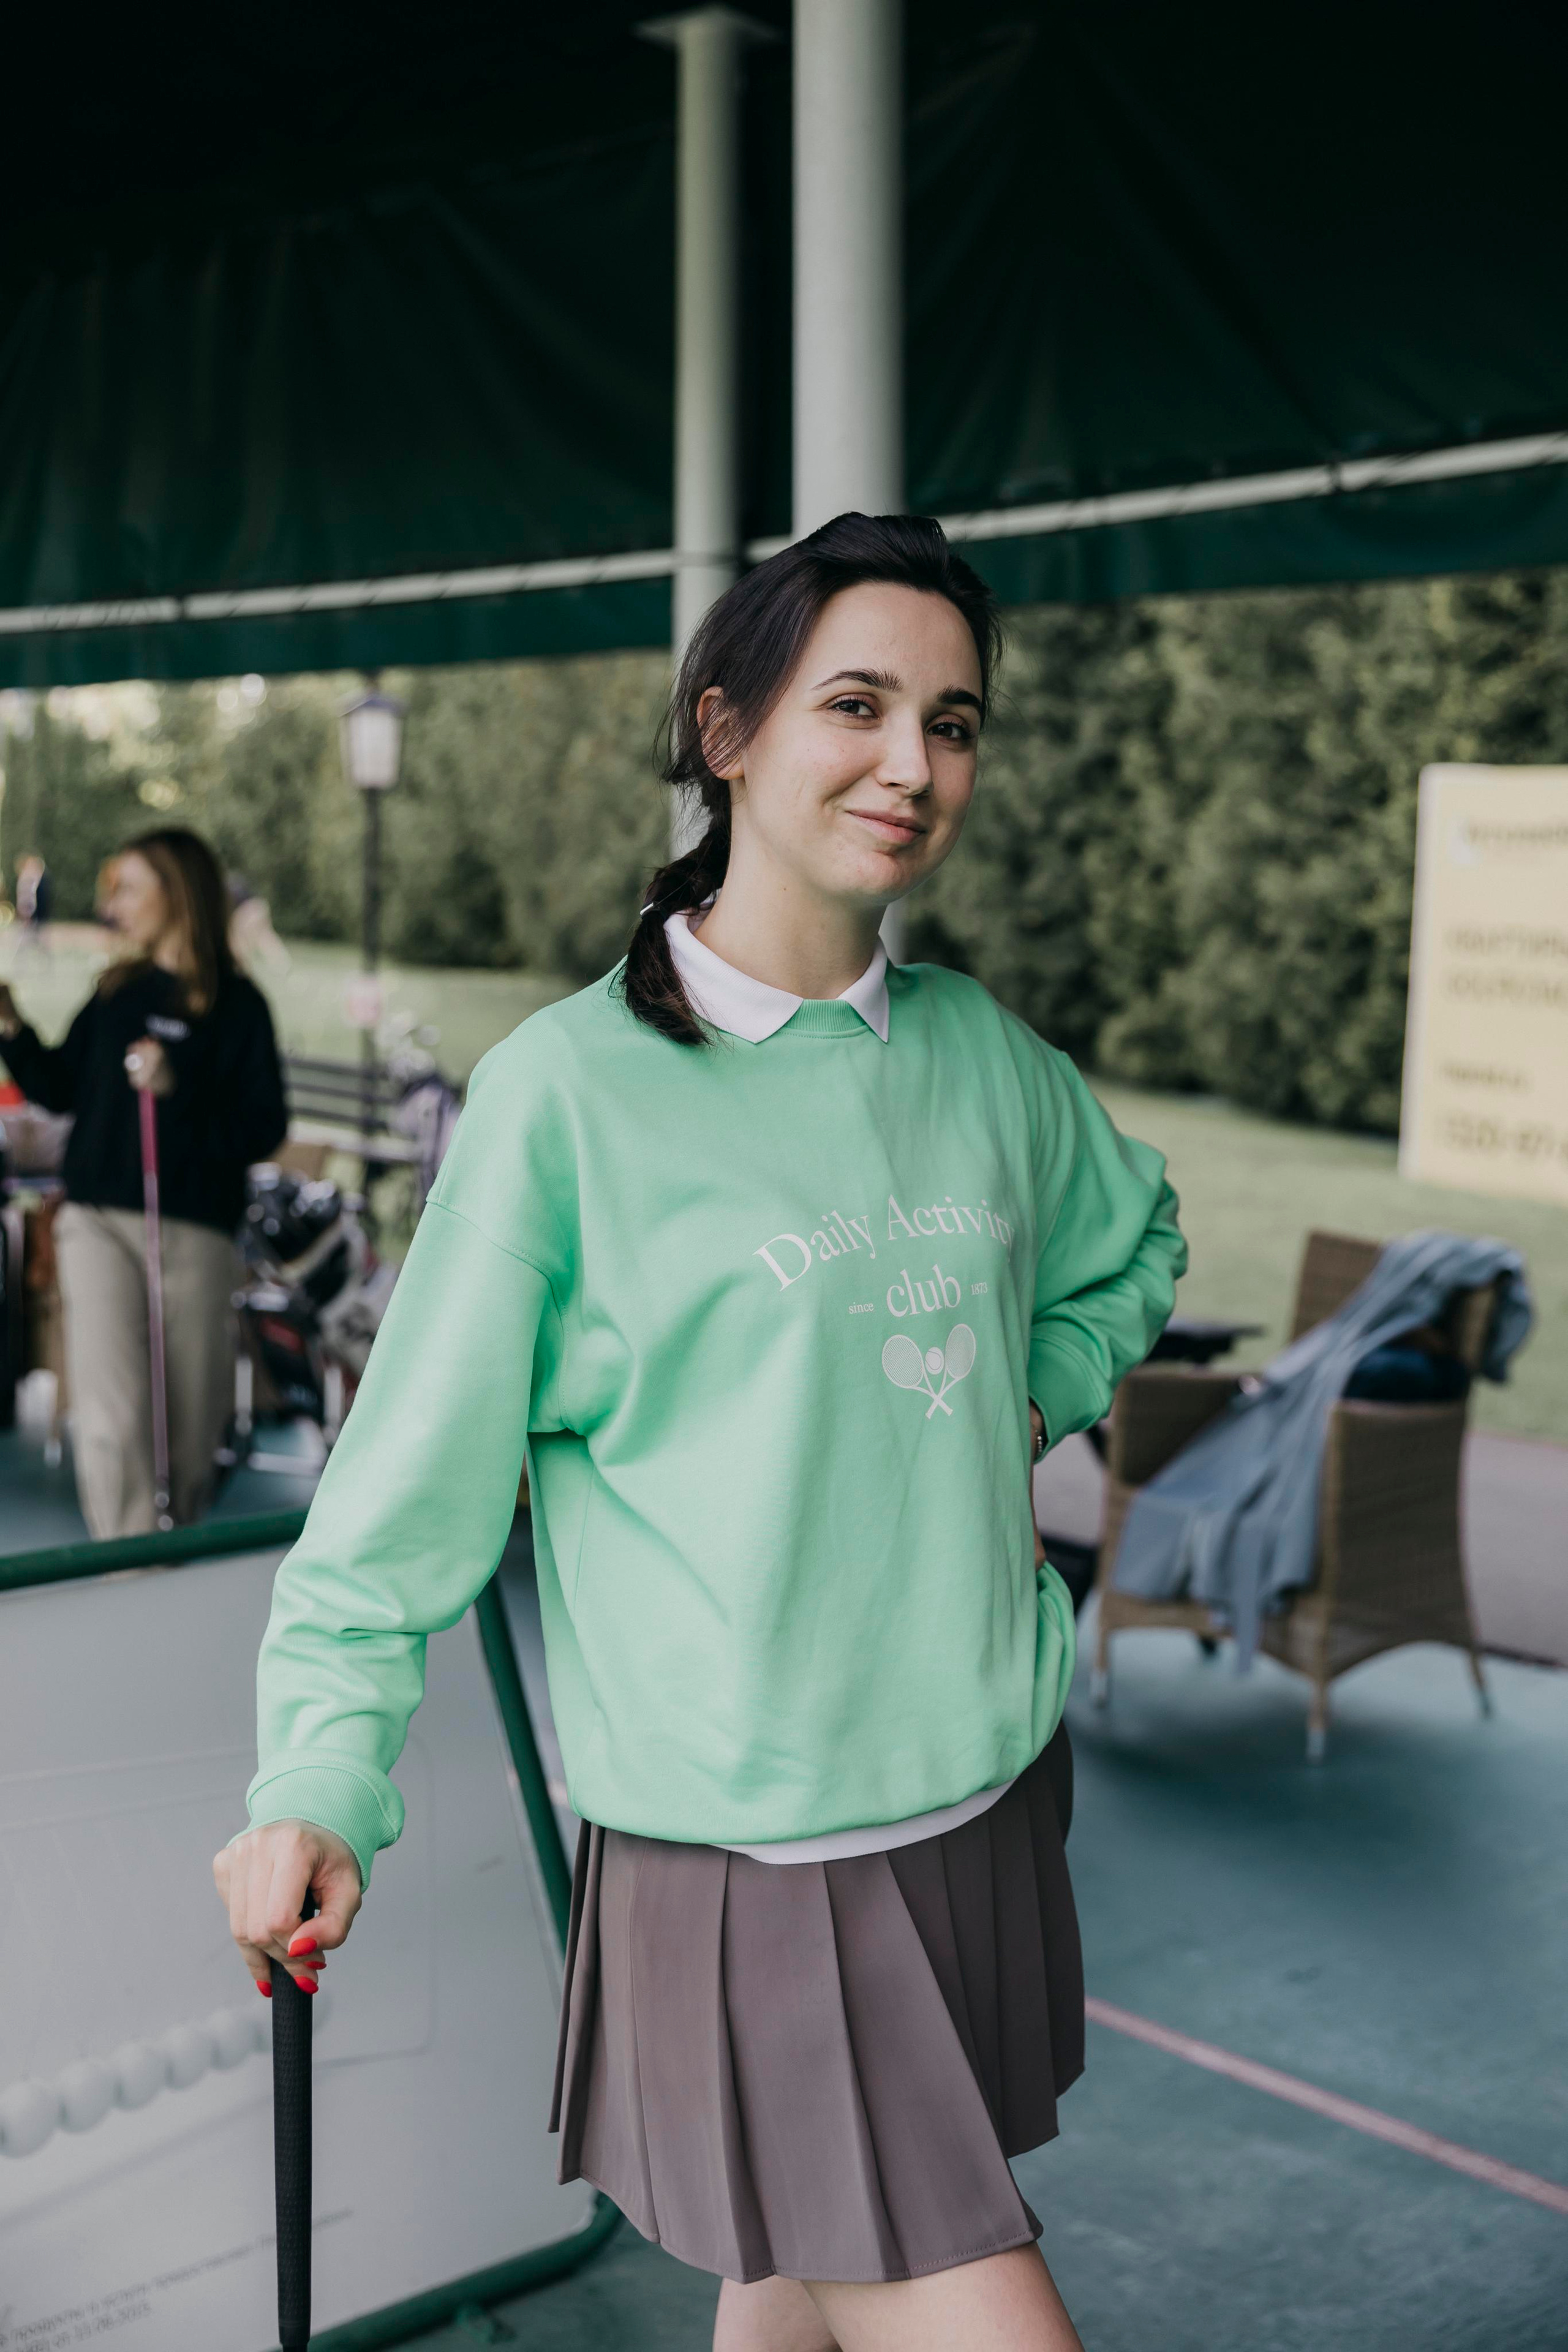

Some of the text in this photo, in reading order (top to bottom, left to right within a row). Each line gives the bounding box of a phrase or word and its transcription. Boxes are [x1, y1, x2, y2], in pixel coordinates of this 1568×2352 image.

[752, 1210, 876, 1292] Daily
[848, 1264, 989, 1317] since club 1873
